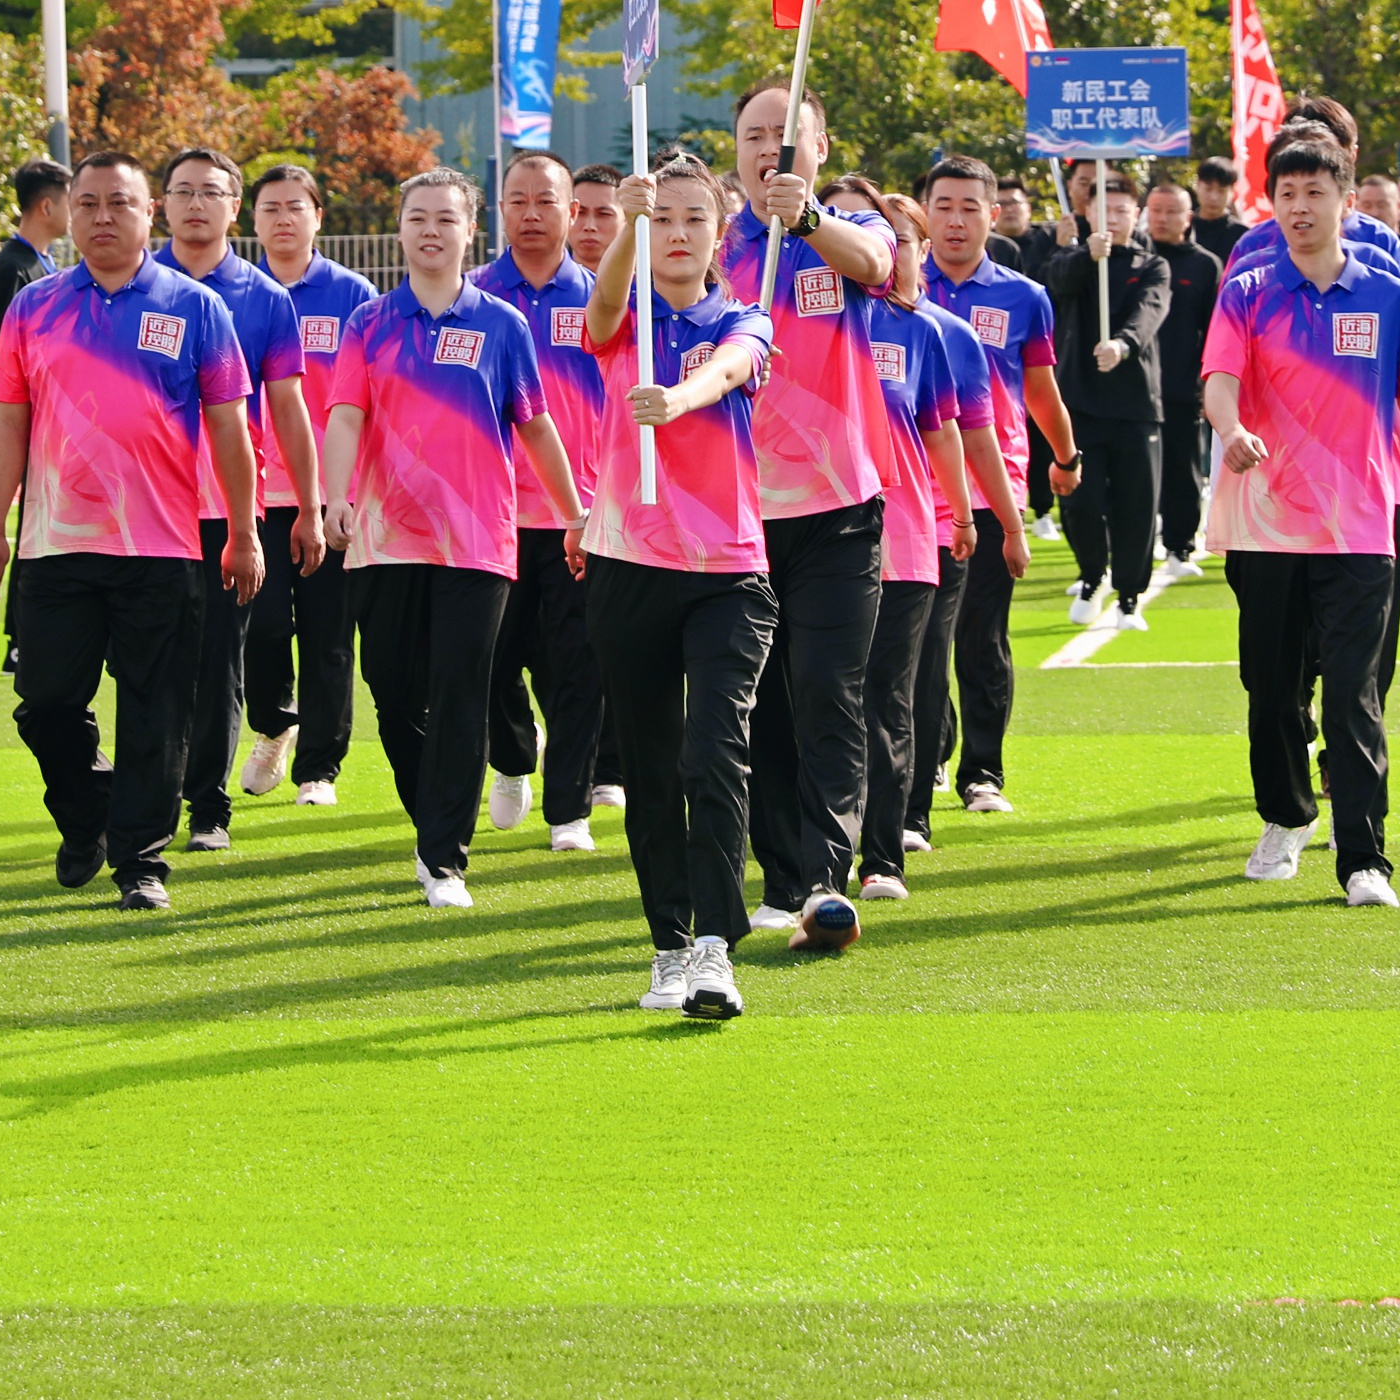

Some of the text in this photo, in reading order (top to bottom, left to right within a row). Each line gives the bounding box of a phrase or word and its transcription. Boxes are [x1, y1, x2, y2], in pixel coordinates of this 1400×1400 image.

[1061, 78, 1152, 103] 新民工会
[1050, 106, 1164, 131] 职工代表队
[803, 273, 835, 291] 近海
[803, 290, 837, 310] 控股
[149, 318, 179, 336] 近海
[307, 321, 333, 335] 近海
[978, 311, 1003, 328] 近海
[1341, 319, 1372, 335] 近海
[146, 331, 176, 351] 控股
[306, 334, 332, 347] 控股
[446, 332, 477, 348] 近海
[977, 325, 1002, 342] 控股
[1341, 334, 1371, 351] 控股
[441, 345, 474, 362] 控股
